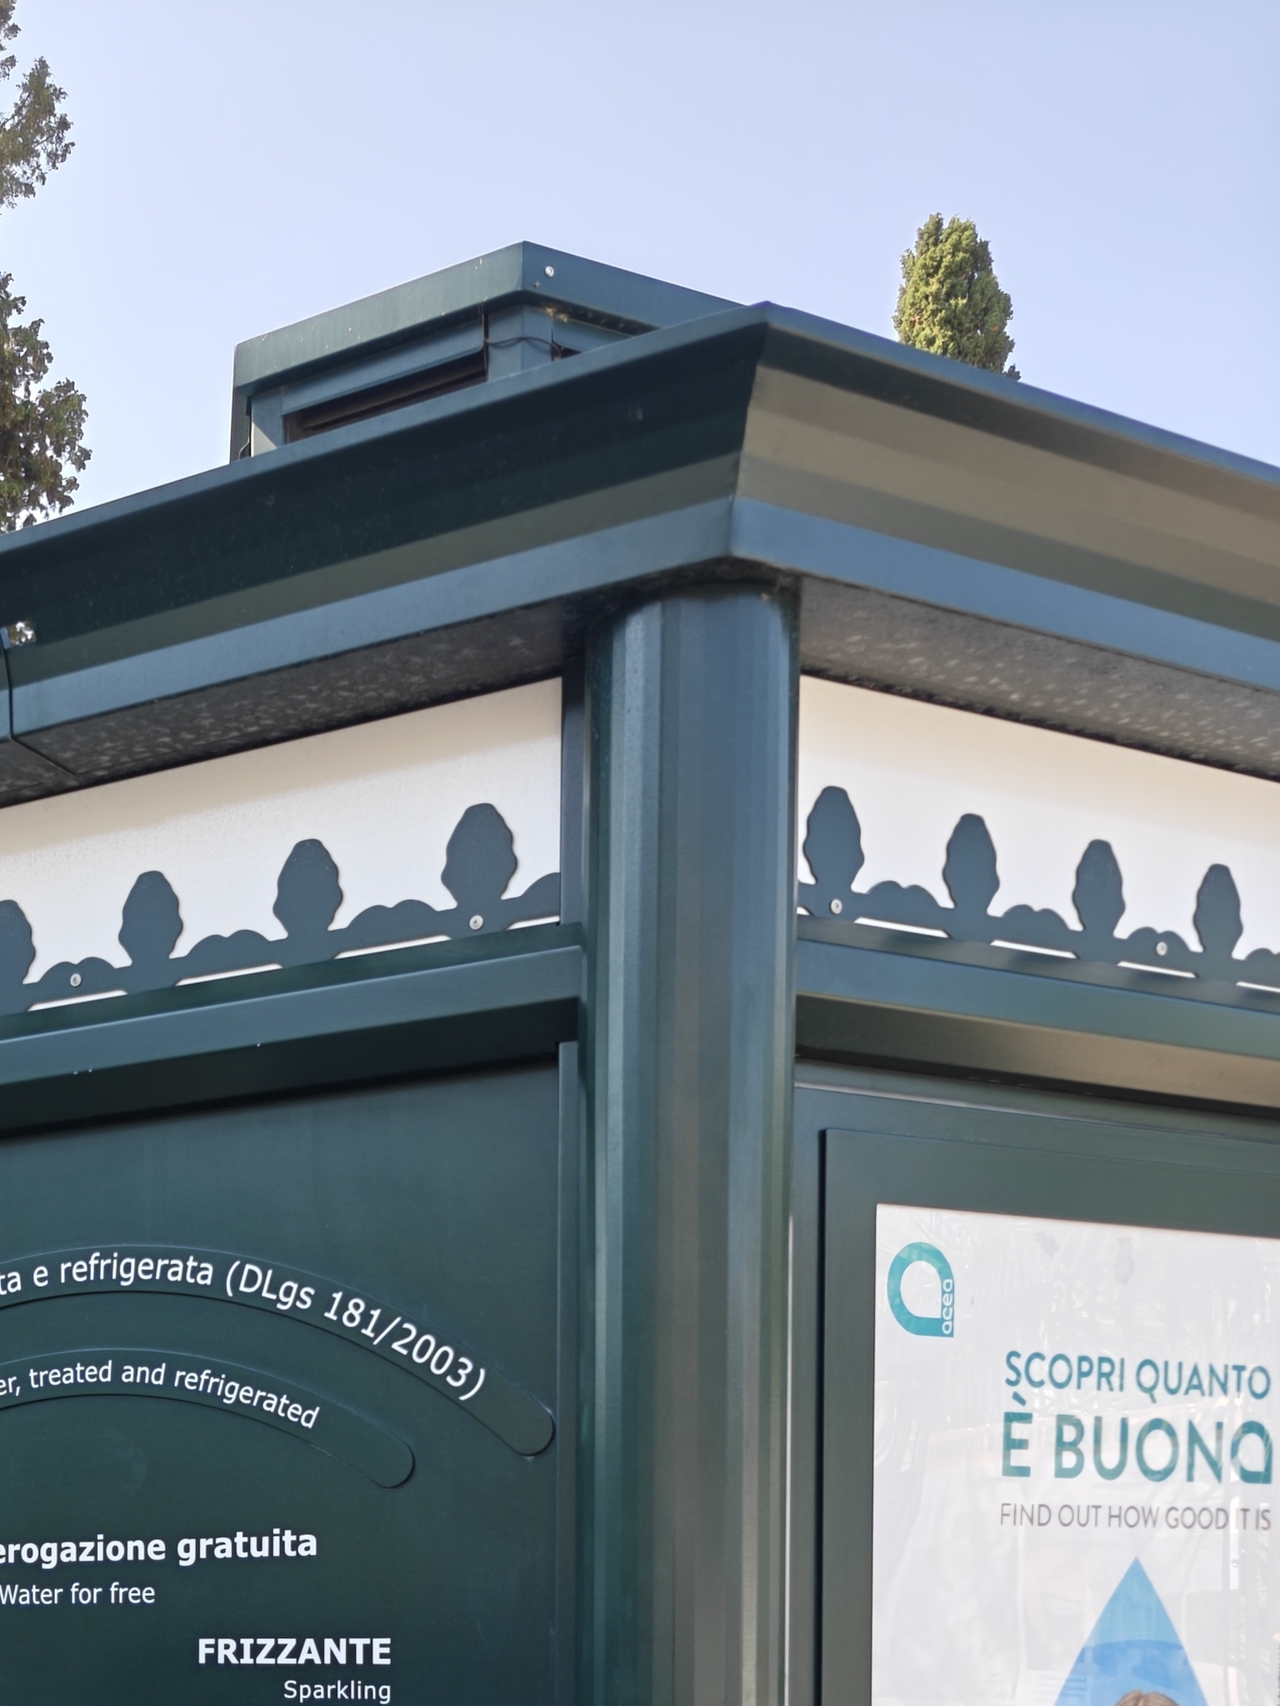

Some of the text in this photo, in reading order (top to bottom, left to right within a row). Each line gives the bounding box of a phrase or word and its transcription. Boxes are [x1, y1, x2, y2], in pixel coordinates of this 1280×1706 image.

[32, 1265, 49, 1288] e
[60, 1251, 214, 1287] refrigerata
[225, 1260, 316, 1311] (DLgs
[323, 1291, 486, 1401] 181/2003)
[942, 1279, 953, 1334] acea
[28, 1359, 113, 1389] treated
[121, 1362, 167, 1386] and
[174, 1369, 321, 1429] refrigerated
[1005, 1351, 1271, 1403] SCOPRI QUANTO
[1002, 1391, 1032, 1477] È
[1001, 1504, 1051, 1526] FIND
[1058, 1505, 1102, 1527] OUT
[1108, 1505, 1160, 1528] HOW
[1166, 1507, 1228, 1529] GOOD
[1256, 1509, 1271, 1529] IS
[177, 1527, 317, 1567] gratuita
[70, 1582, 103, 1605] for
[109, 1581, 156, 1604] free
[198, 1637, 392, 1665] FRIZZANTE
[283, 1679, 391, 1705] Sparkling
